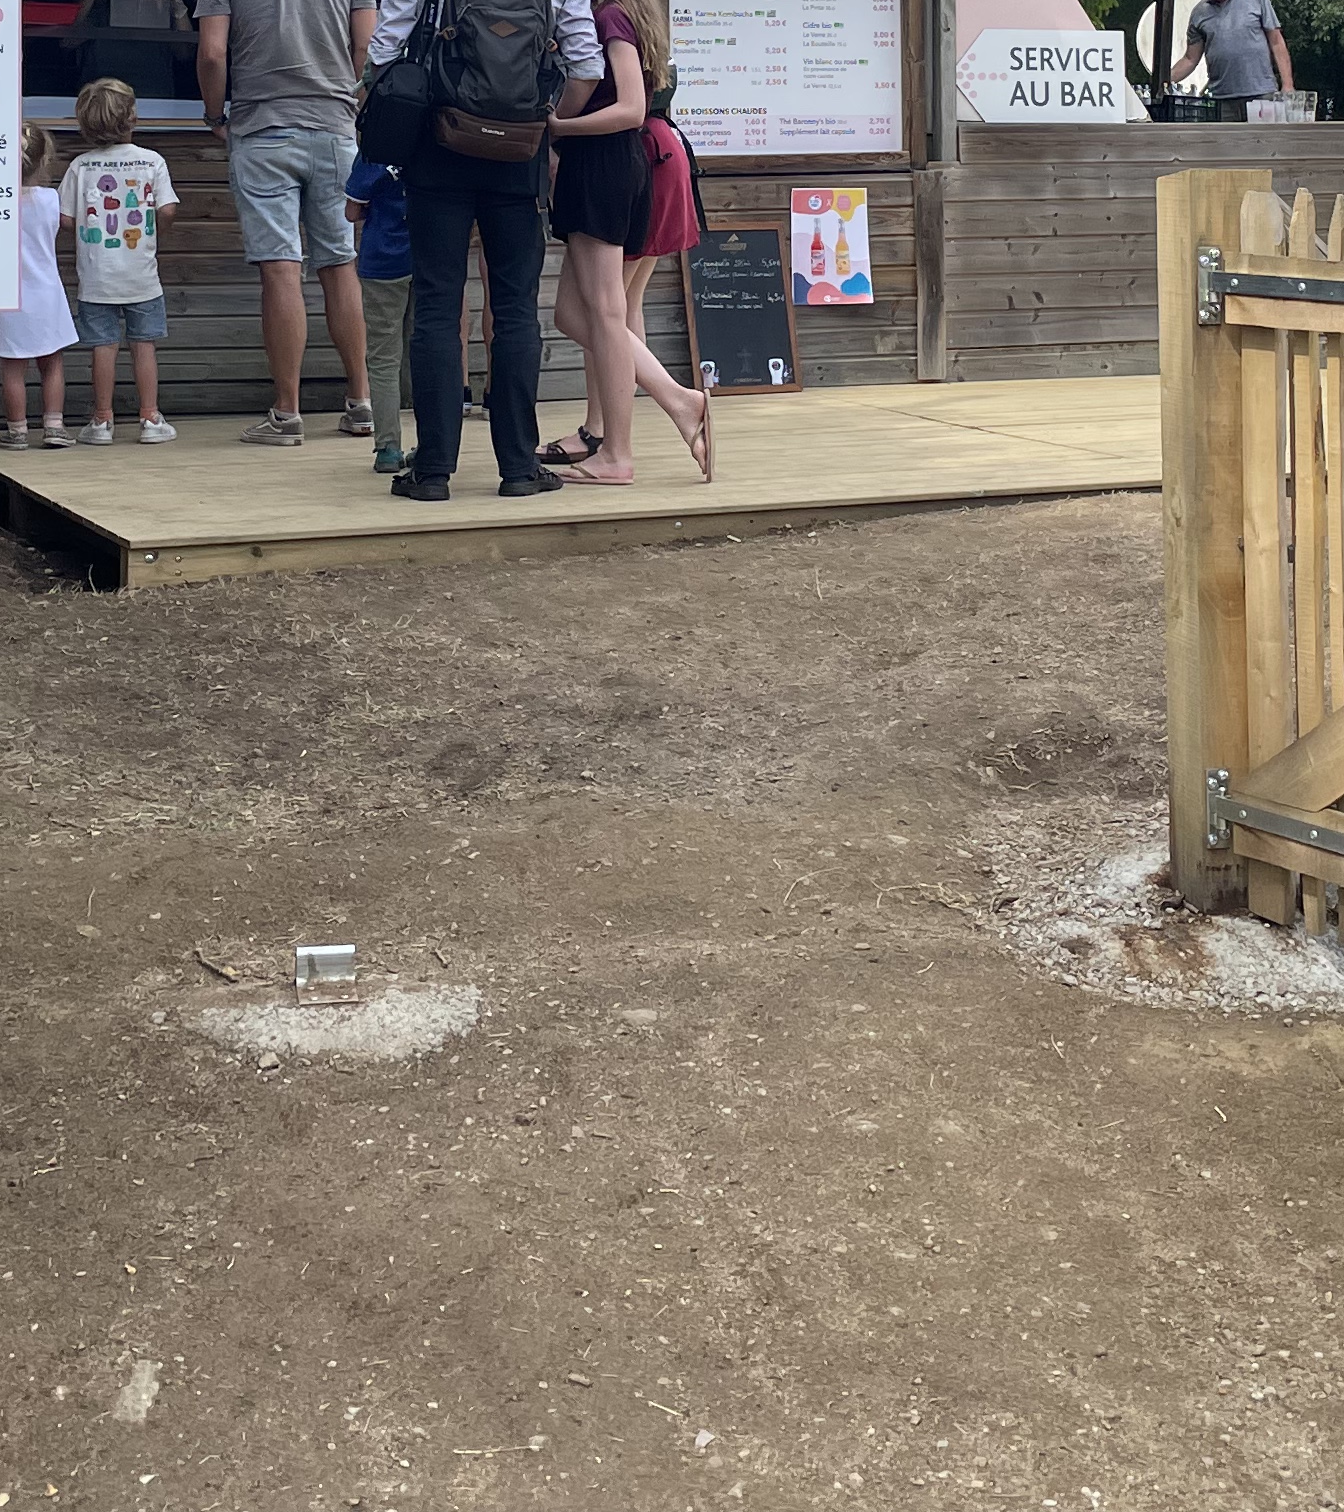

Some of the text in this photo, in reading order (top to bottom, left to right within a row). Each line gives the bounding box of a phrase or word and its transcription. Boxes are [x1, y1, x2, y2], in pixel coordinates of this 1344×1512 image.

[1008, 46, 1115, 73] SERVICE
[1008, 80, 1116, 108] AU BAR
[675, 107, 768, 116] LES BOISSONS CHAUDES
